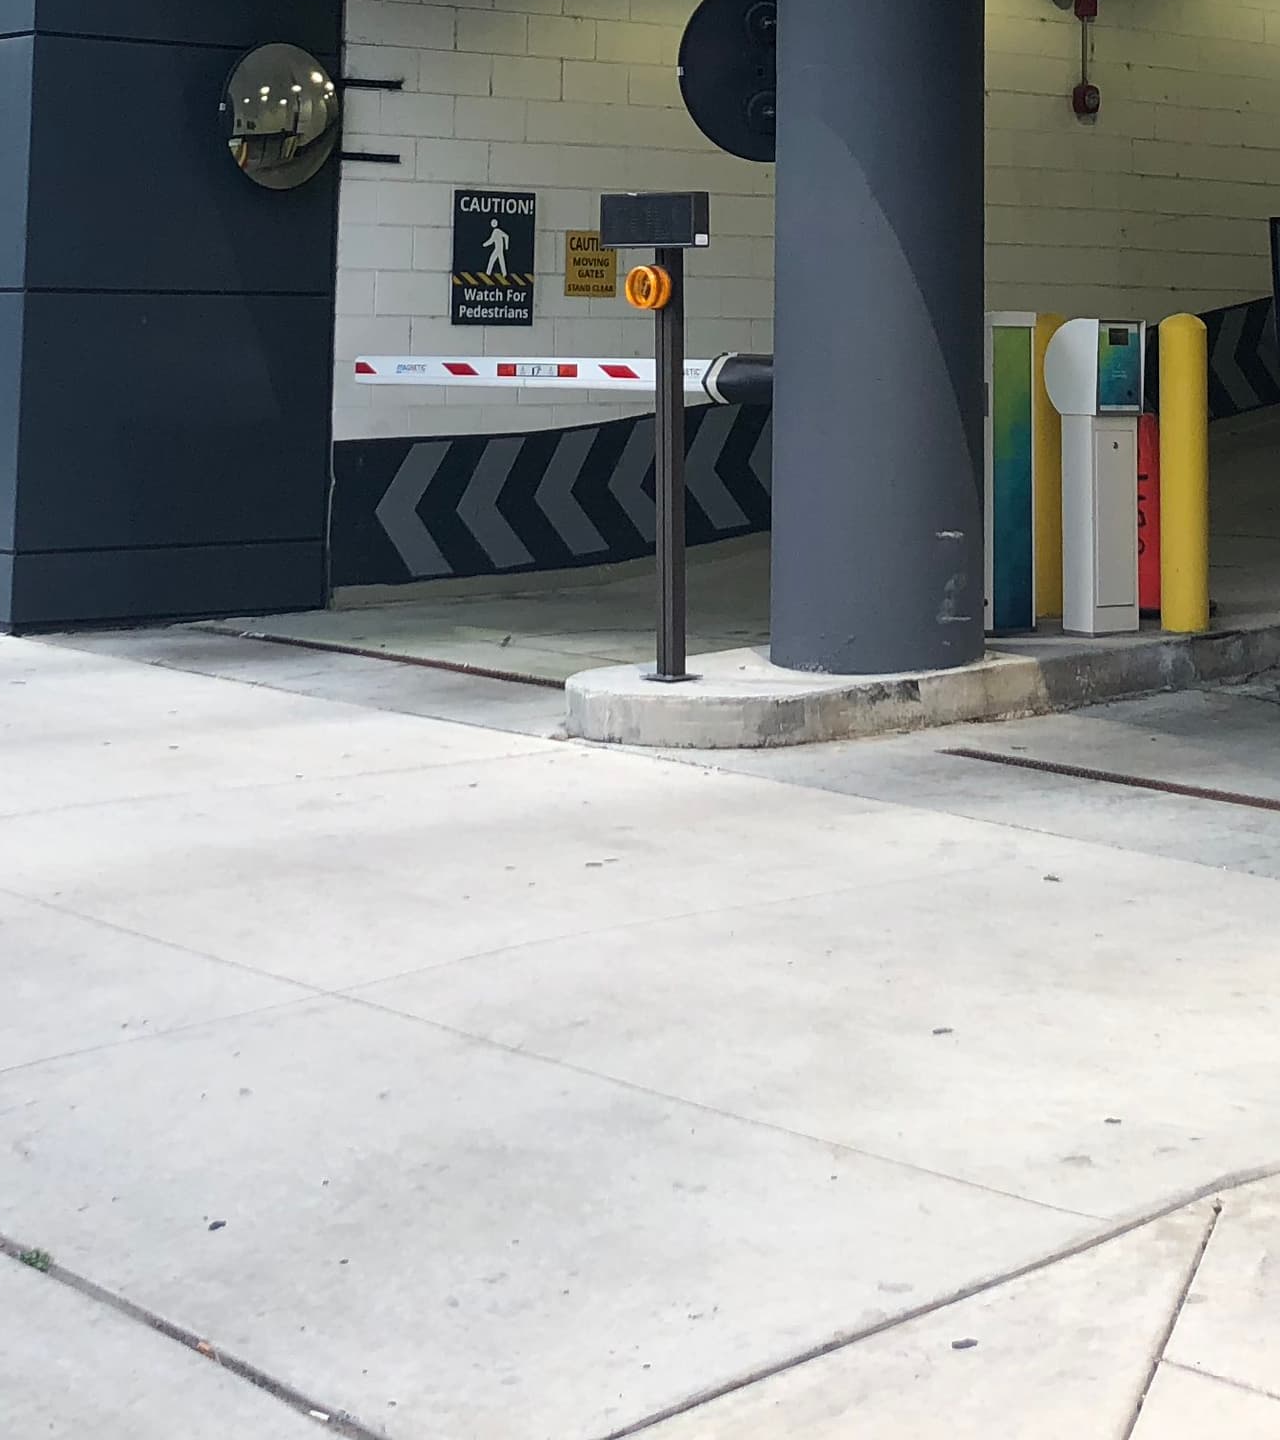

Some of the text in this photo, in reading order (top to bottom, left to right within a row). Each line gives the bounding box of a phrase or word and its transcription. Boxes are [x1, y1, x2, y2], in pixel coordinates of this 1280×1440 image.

[460, 196, 534, 215] CAUTION!
[569, 236, 614, 252] CAUTI
[572, 257, 609, 267] MOVING
[577, 269, 605, 279] GATES
[463, 287, 527, 302] Watch For
[567, 283, 613, 292] STAND CLEAR
[458, 304, 529, 319] Pedestrians
